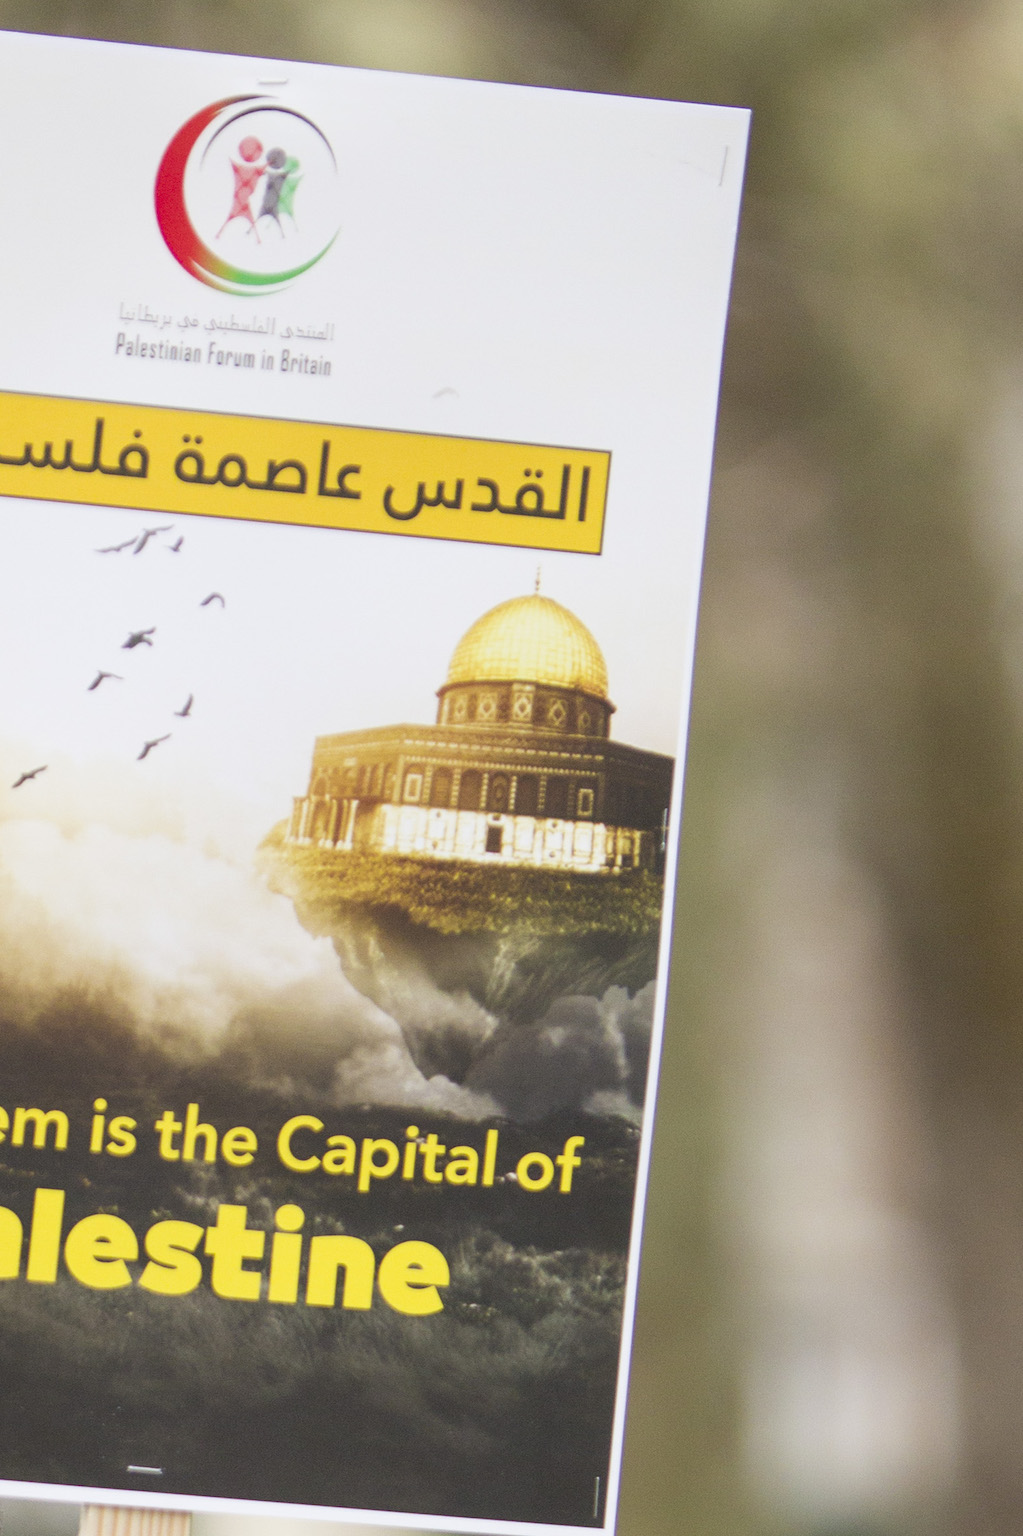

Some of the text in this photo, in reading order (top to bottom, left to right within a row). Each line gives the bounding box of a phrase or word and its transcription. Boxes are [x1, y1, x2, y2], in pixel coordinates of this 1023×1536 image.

[115, 332, 332, 376] Palestinian Forum in Britain
[177, 314, 200, 333] في
[173, 432, 363, 500] عاصمة
[382, 461, 592, 523] القدس
[89, 1098, 139, 1157] is
[156, 1102, 258, 1168] the
[277, 1114, 499, 1192] Capital
[516, 1135, 586, 1193] of
